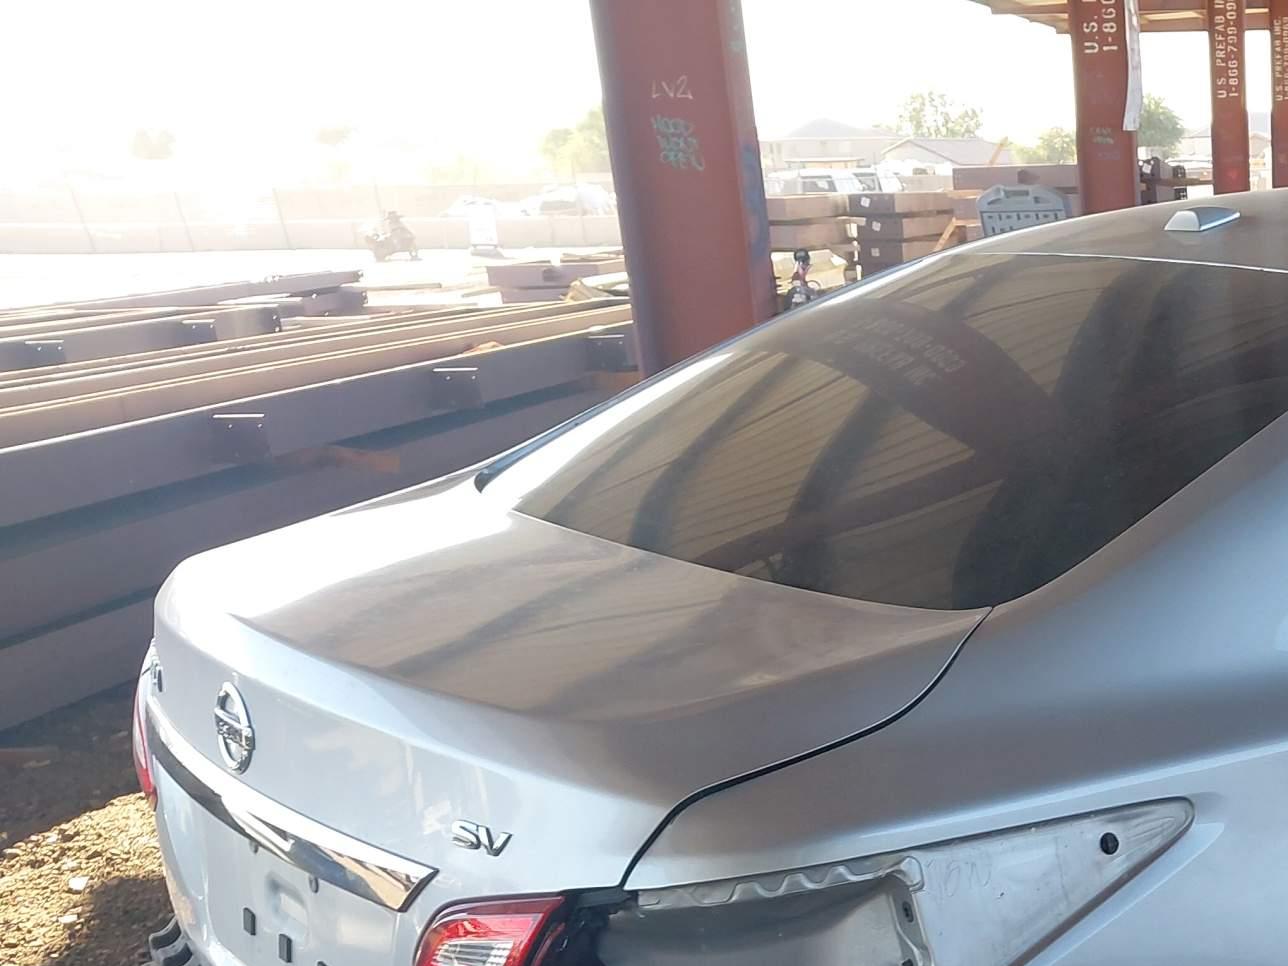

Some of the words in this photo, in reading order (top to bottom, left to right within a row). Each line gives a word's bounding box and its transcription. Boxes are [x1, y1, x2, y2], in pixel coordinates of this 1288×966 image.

[1083, 16, 1099, 53] U.S.
[1214, 15, 1226, 67] PREFAB
[1225, 0, 1239, 97] 1-866-799-09
[651, 74, 694, 100] LV2
[451, 818, 514, 857] SV
